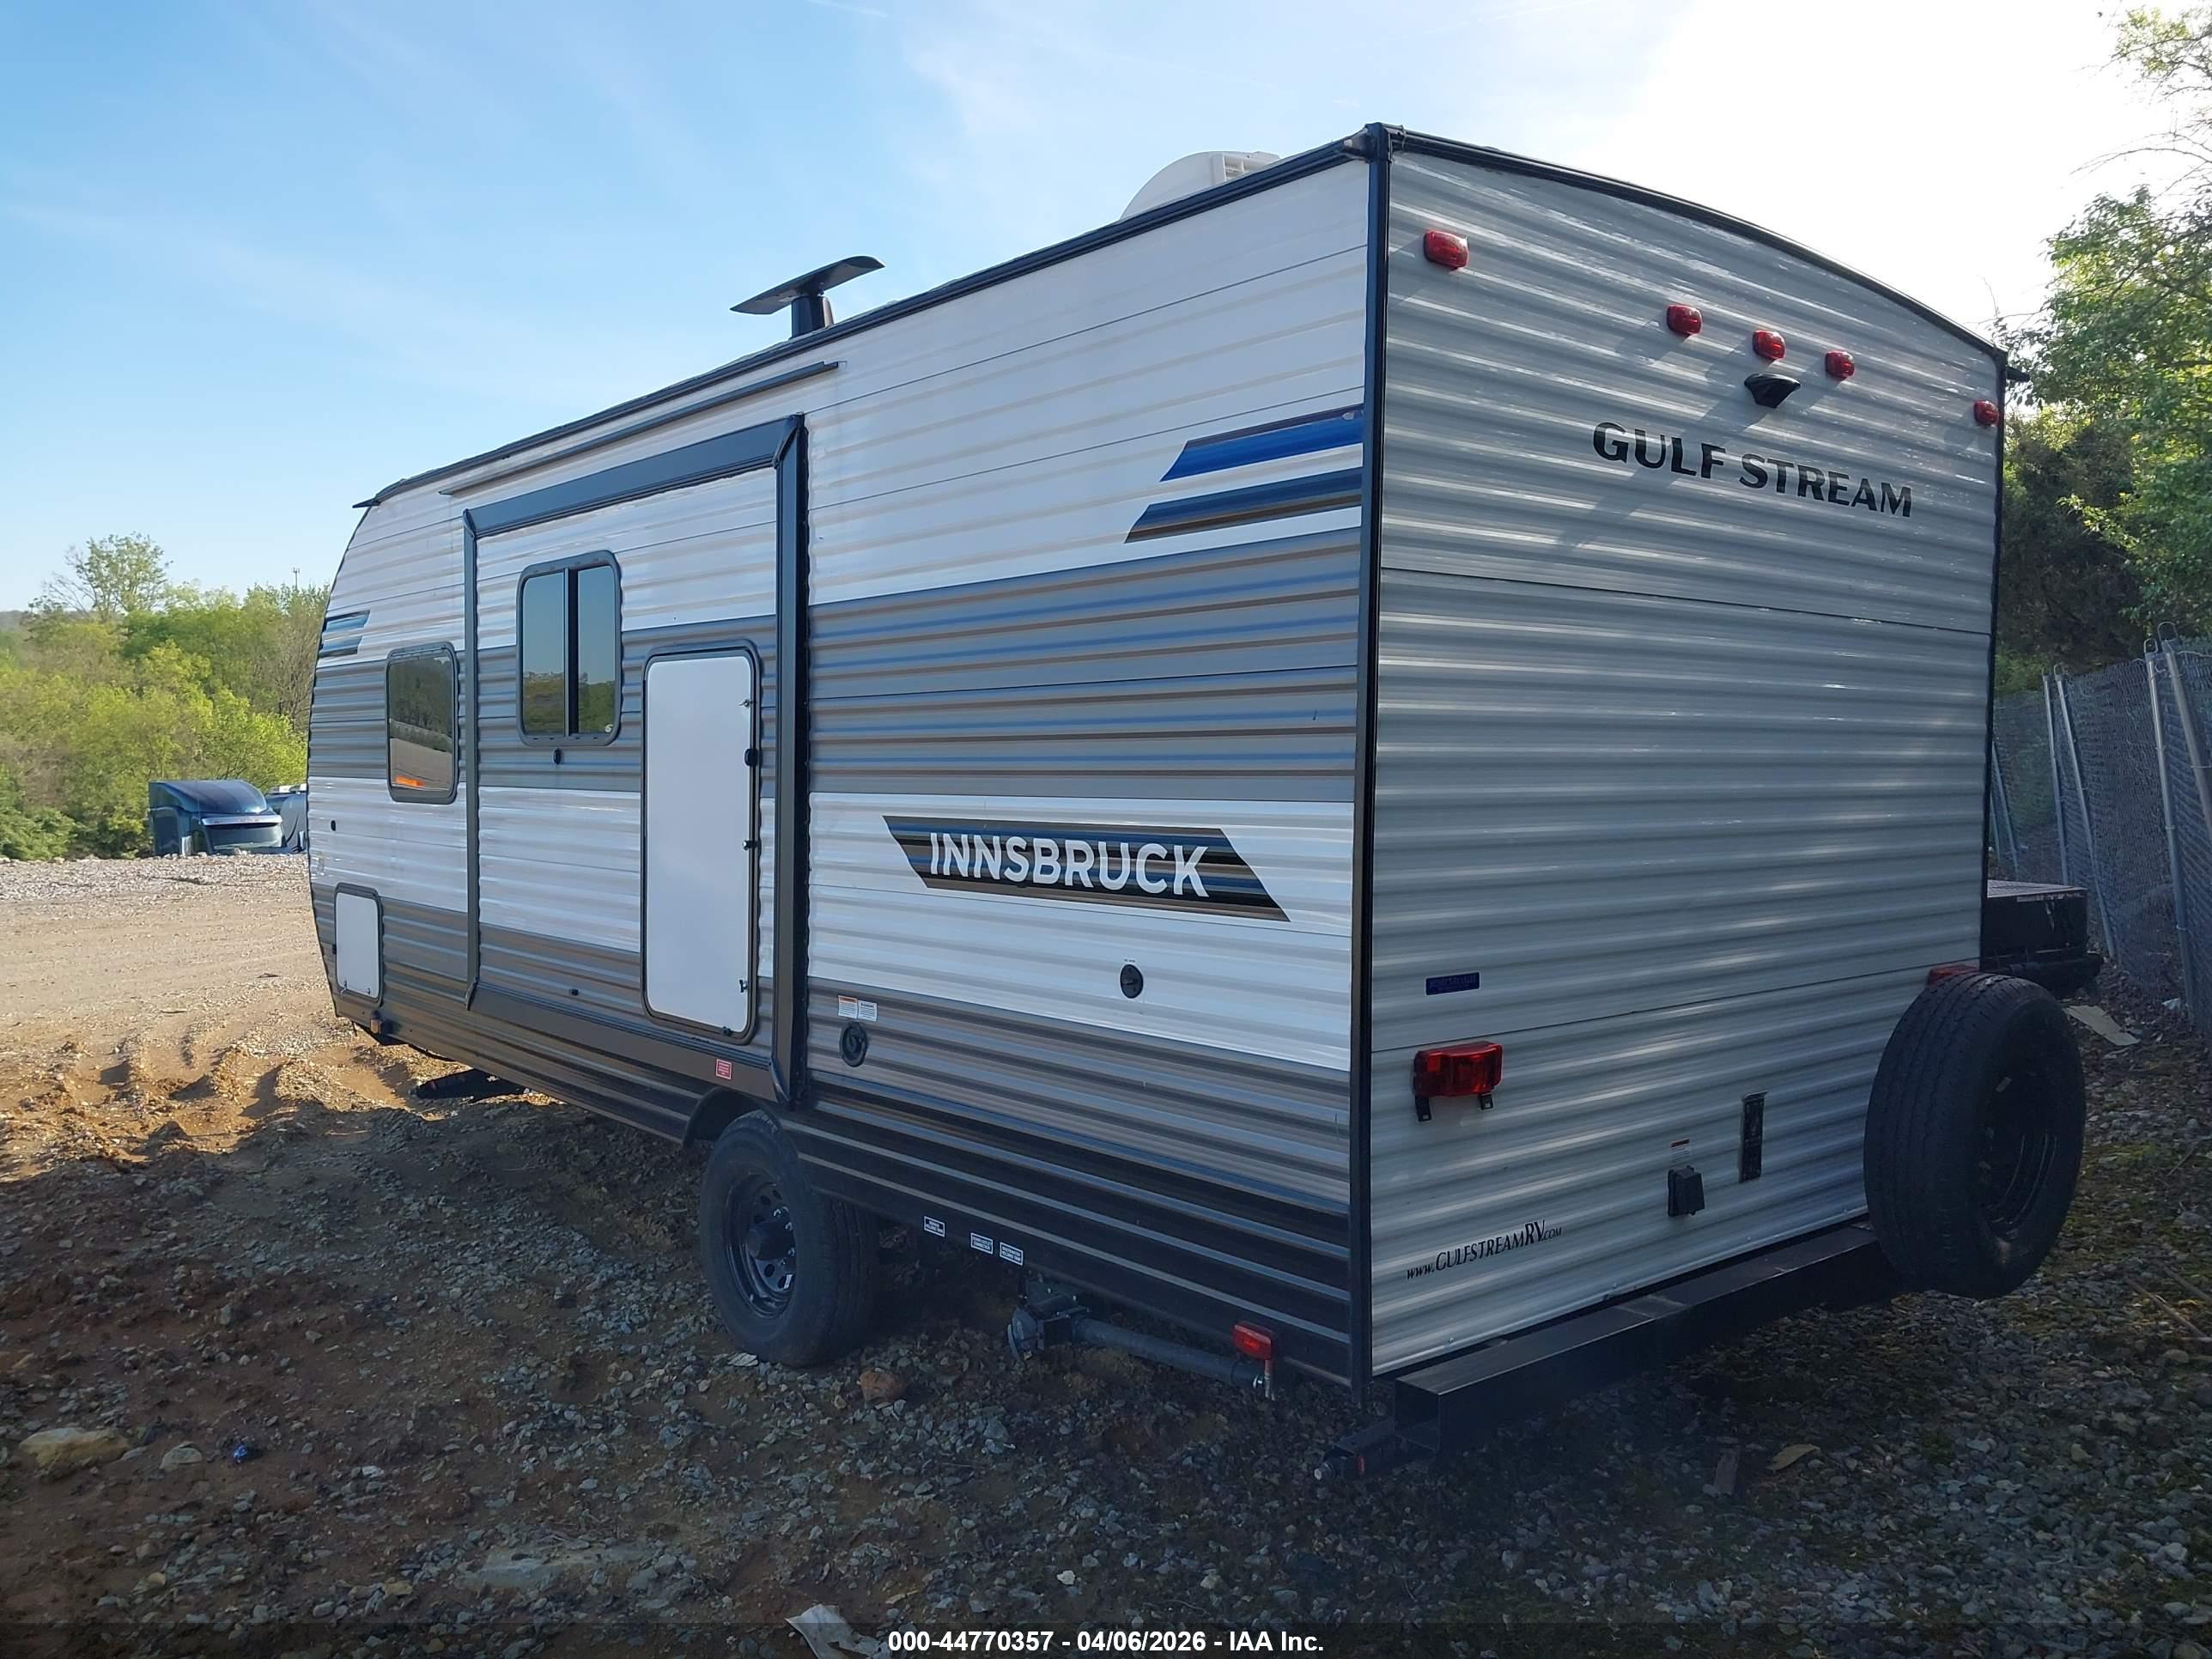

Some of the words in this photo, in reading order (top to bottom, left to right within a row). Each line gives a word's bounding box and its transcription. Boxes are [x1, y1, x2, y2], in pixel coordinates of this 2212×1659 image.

[1593, 422, 1726, 479] GULF
[1739, 453, 1911, 517] STREAM
[930, 832, 1209, 897] INNSBRUCK
